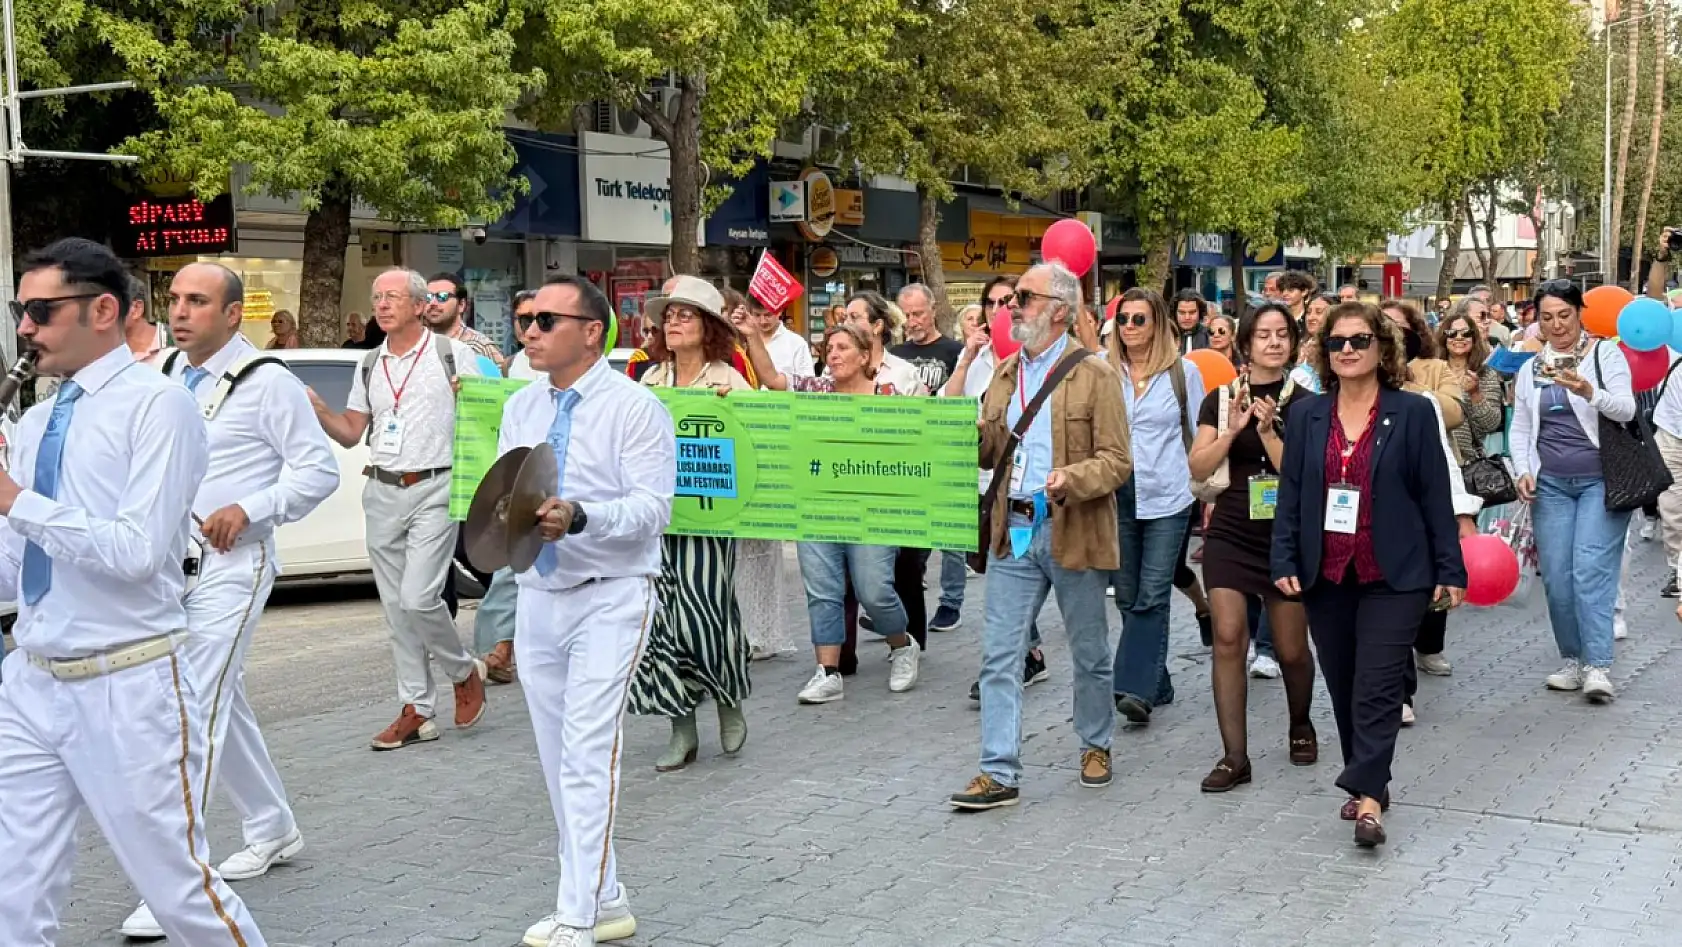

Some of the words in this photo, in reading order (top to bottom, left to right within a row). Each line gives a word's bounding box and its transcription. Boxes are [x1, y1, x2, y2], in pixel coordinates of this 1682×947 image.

[595, 178, 622, 198] Türk
[676, 460, 732, 476] LUSLARARASI
[831, 458, 932, 479] şehrinfestivali
